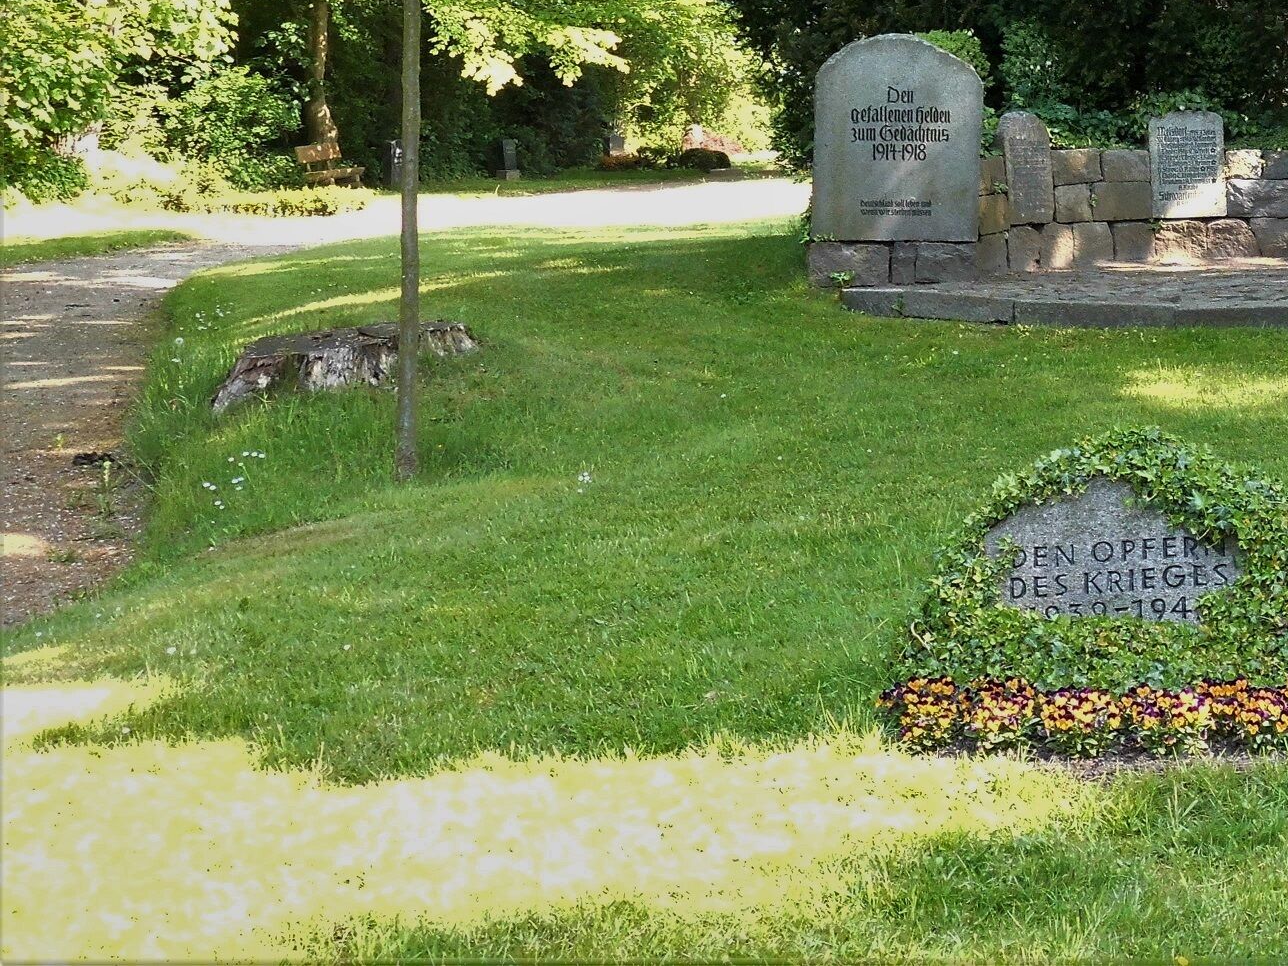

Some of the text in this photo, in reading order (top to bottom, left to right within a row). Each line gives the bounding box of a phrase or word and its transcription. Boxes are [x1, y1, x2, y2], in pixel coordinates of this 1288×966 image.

[887, 86, 914, 103] Den
[851, 105, 951, 124] gefallenen Helden
[851, 125, 949, 143] zum Gedächtnis
[872, 143, 927, 161] 1914-1918
[1010, 536, 1226, 569] DEN OPFERN
[1009, 563, 1228, 599] DES KRIEGES
